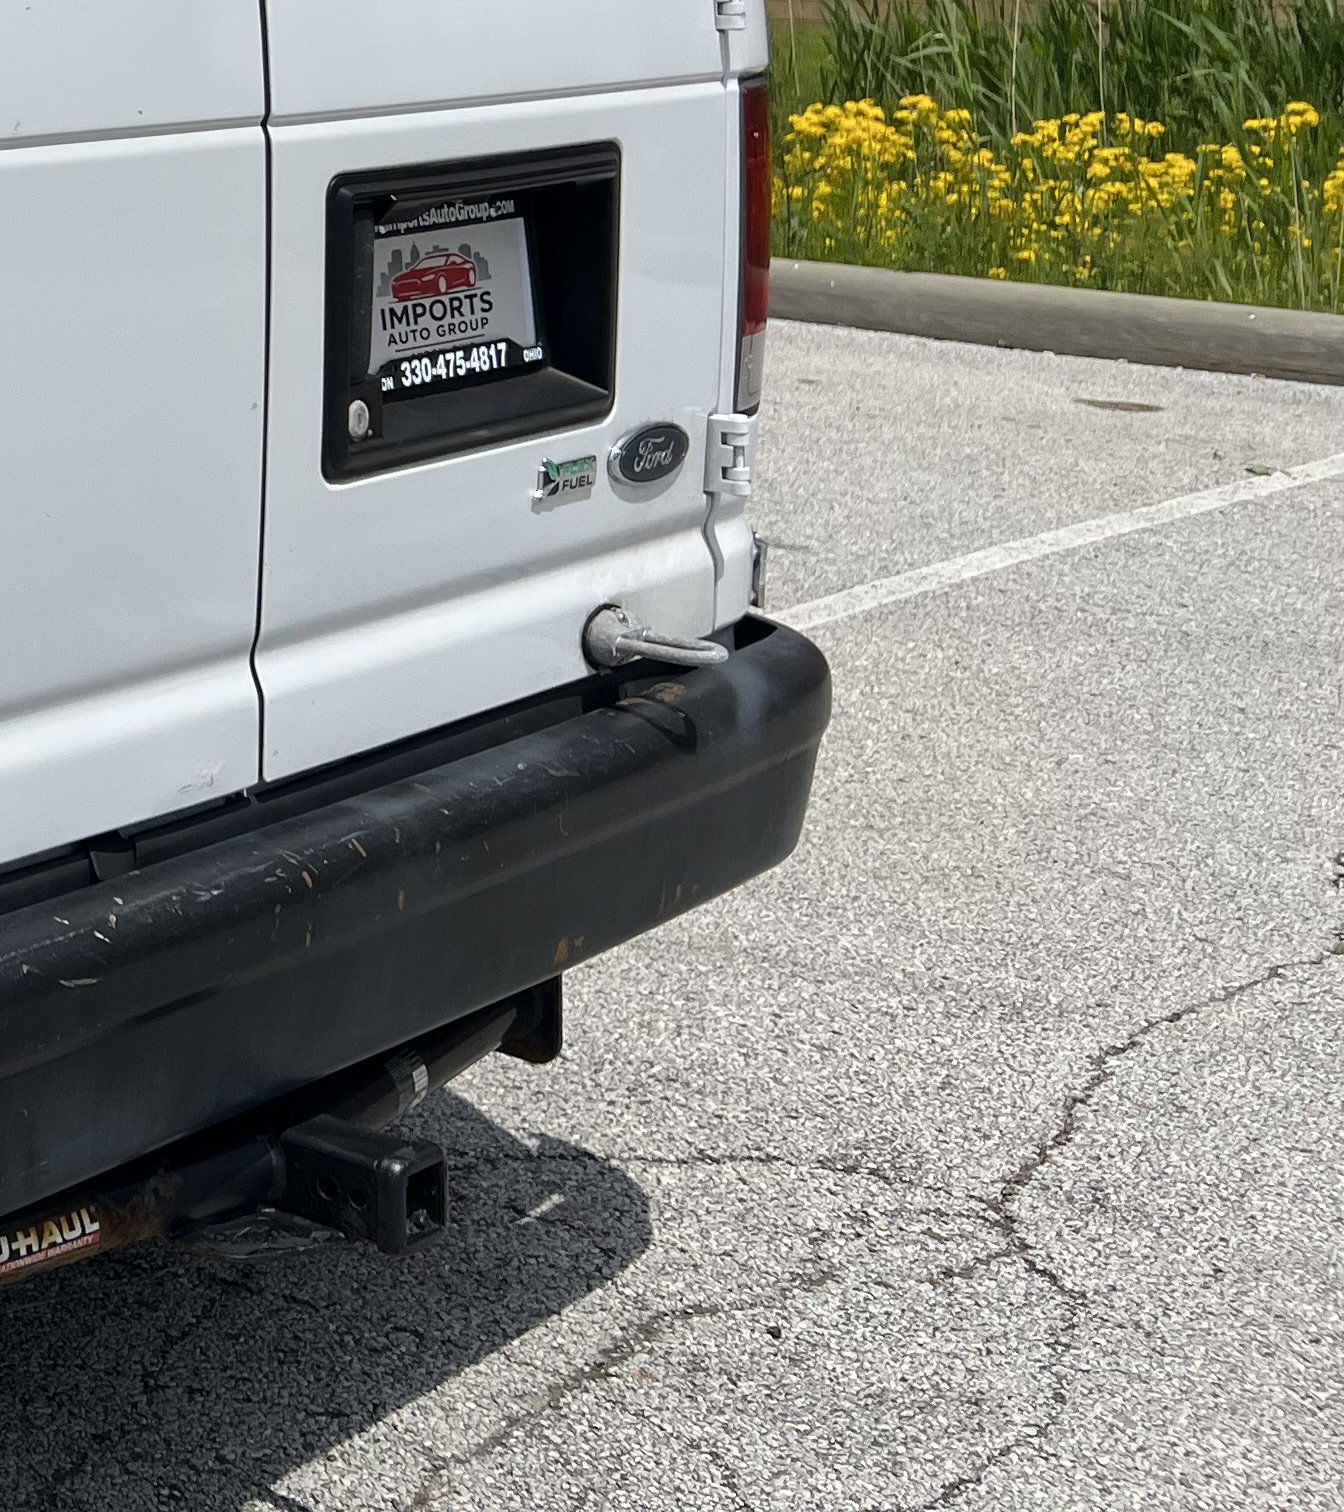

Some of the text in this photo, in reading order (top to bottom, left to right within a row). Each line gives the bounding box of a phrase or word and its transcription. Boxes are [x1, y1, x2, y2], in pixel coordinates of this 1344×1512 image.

[380, 291, 493, 331] IMPORTS
[387, 317, 489, 347] AUTO GROUP
[400, 342, 507, 387] 330-475-4817
[634, 436, 674, 473] Ford
[562, 475, 593, 491] FUEL
